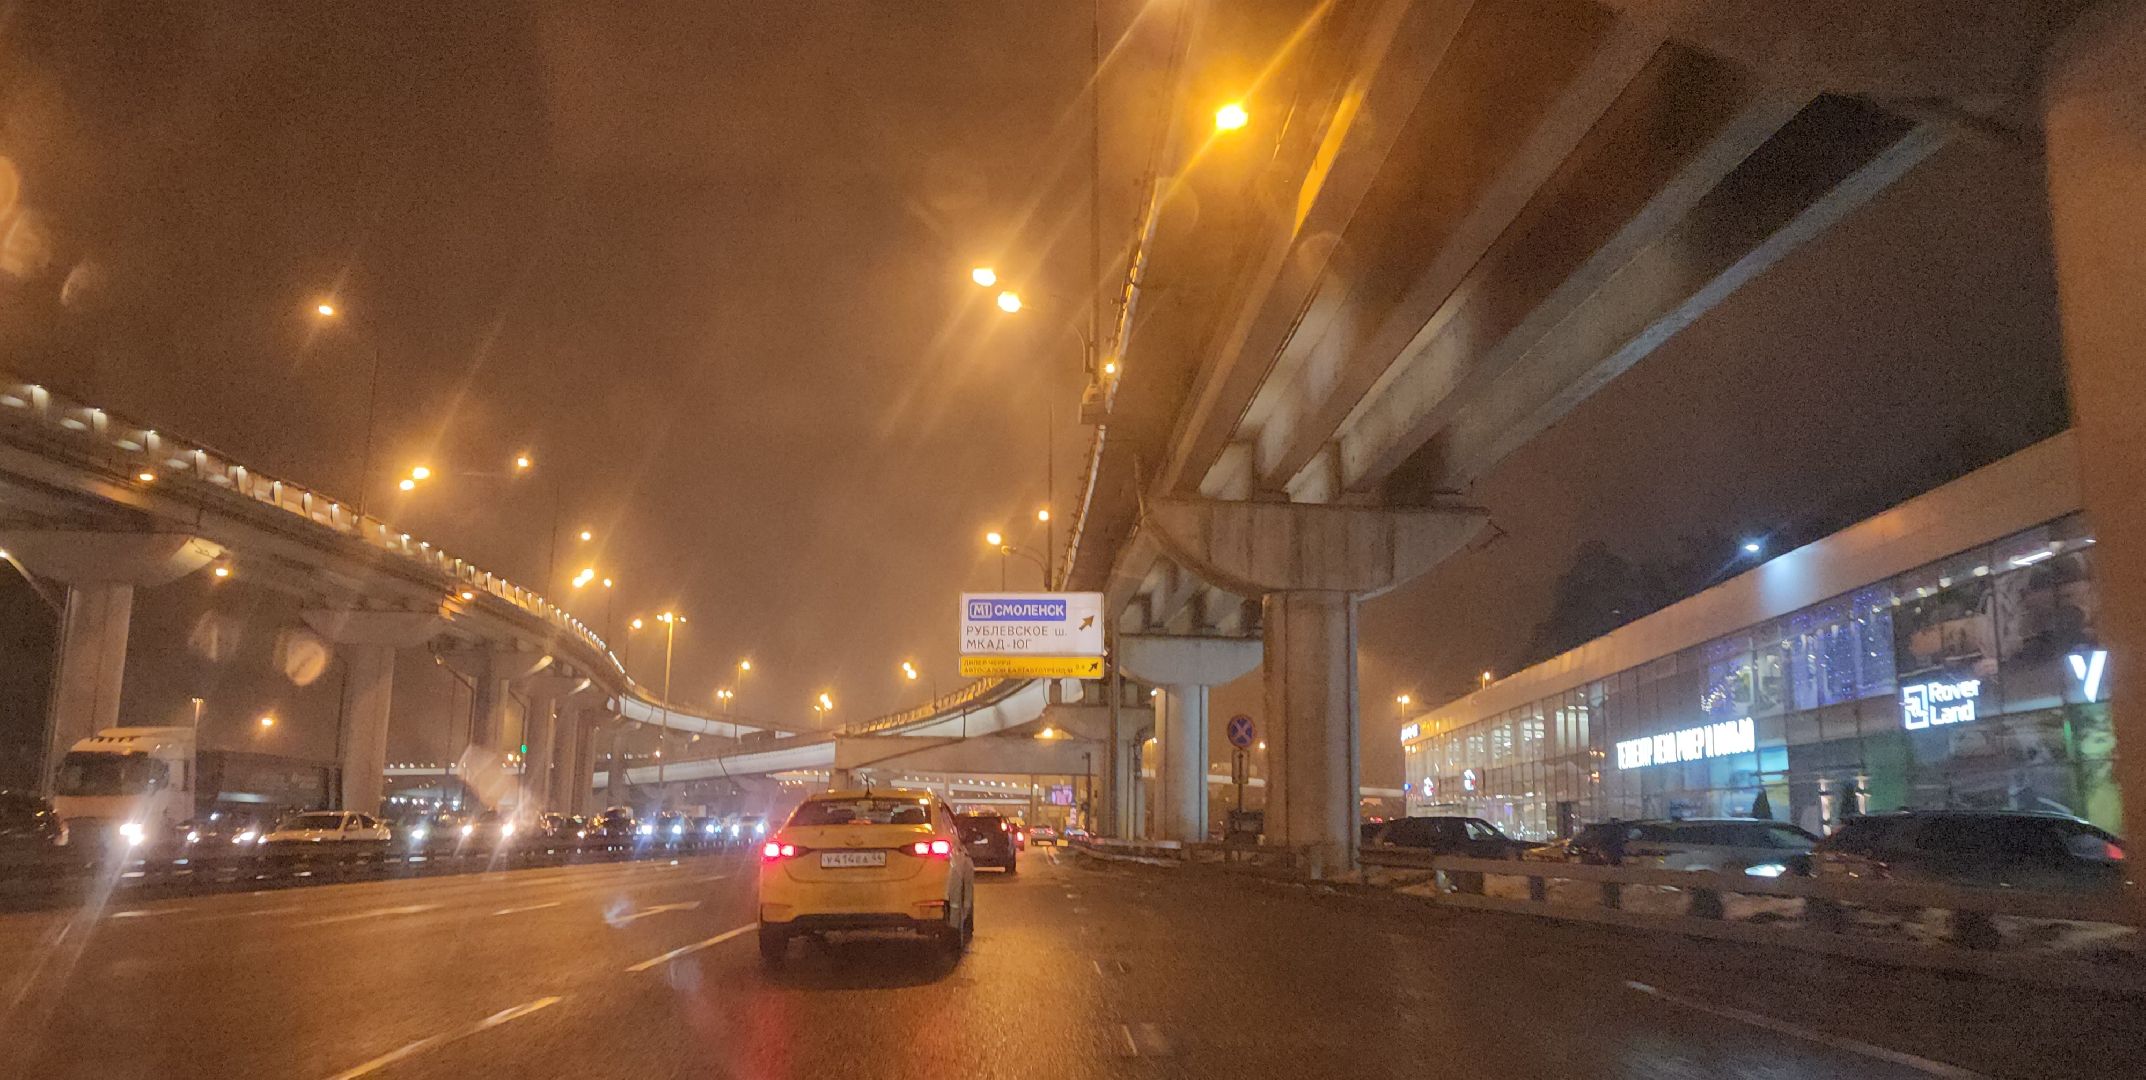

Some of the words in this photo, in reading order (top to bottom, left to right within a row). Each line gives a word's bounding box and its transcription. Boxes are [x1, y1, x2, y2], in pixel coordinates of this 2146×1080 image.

[994, 604, 1065, 617] СМОЛЕНСК
[966, 625, 1049, 637] РУБЛЕВСКОЕ
[966, 639, 1033, 651] МКАД-ЮГ
[1928, 680, 1980, 703] Rover
[1929, 699, 1976, 726] Land
